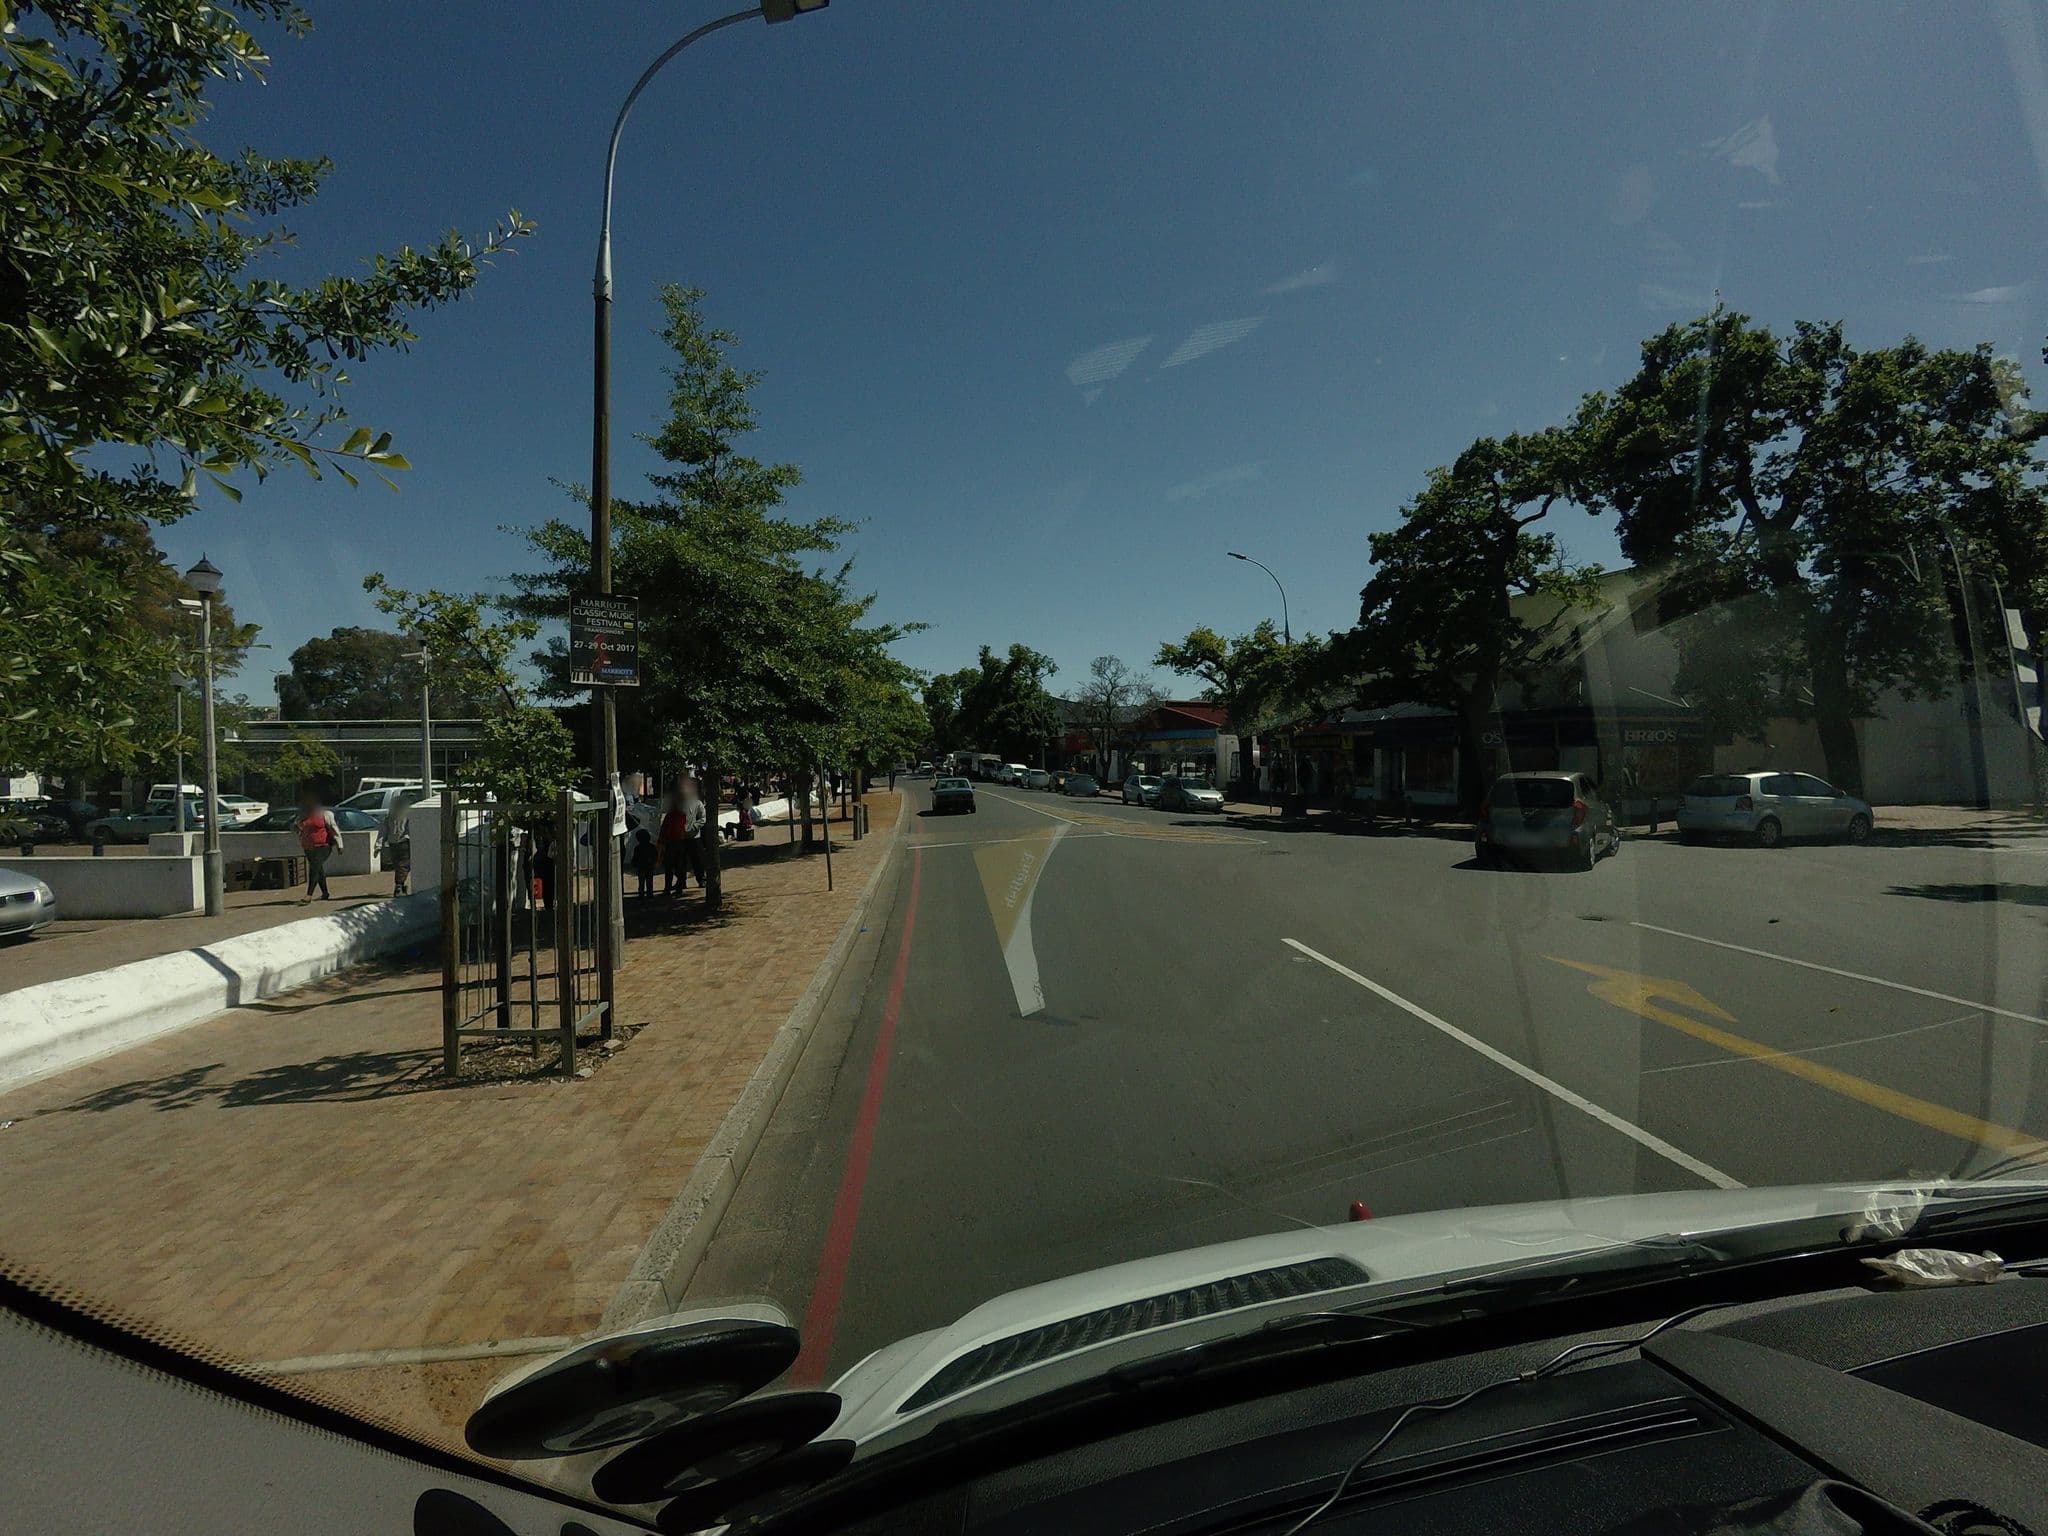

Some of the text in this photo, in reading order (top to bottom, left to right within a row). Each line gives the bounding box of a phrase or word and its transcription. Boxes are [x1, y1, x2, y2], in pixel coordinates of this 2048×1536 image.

[580, 599, 628, 610] MARRIOTT
[573, 607, 635, 621] CLASSIC MUSIC
[586, 617, 622, 628] FESTIVAL
[600, 642, 615, 651] Oct
[616, 644, 635, 652] 2017
